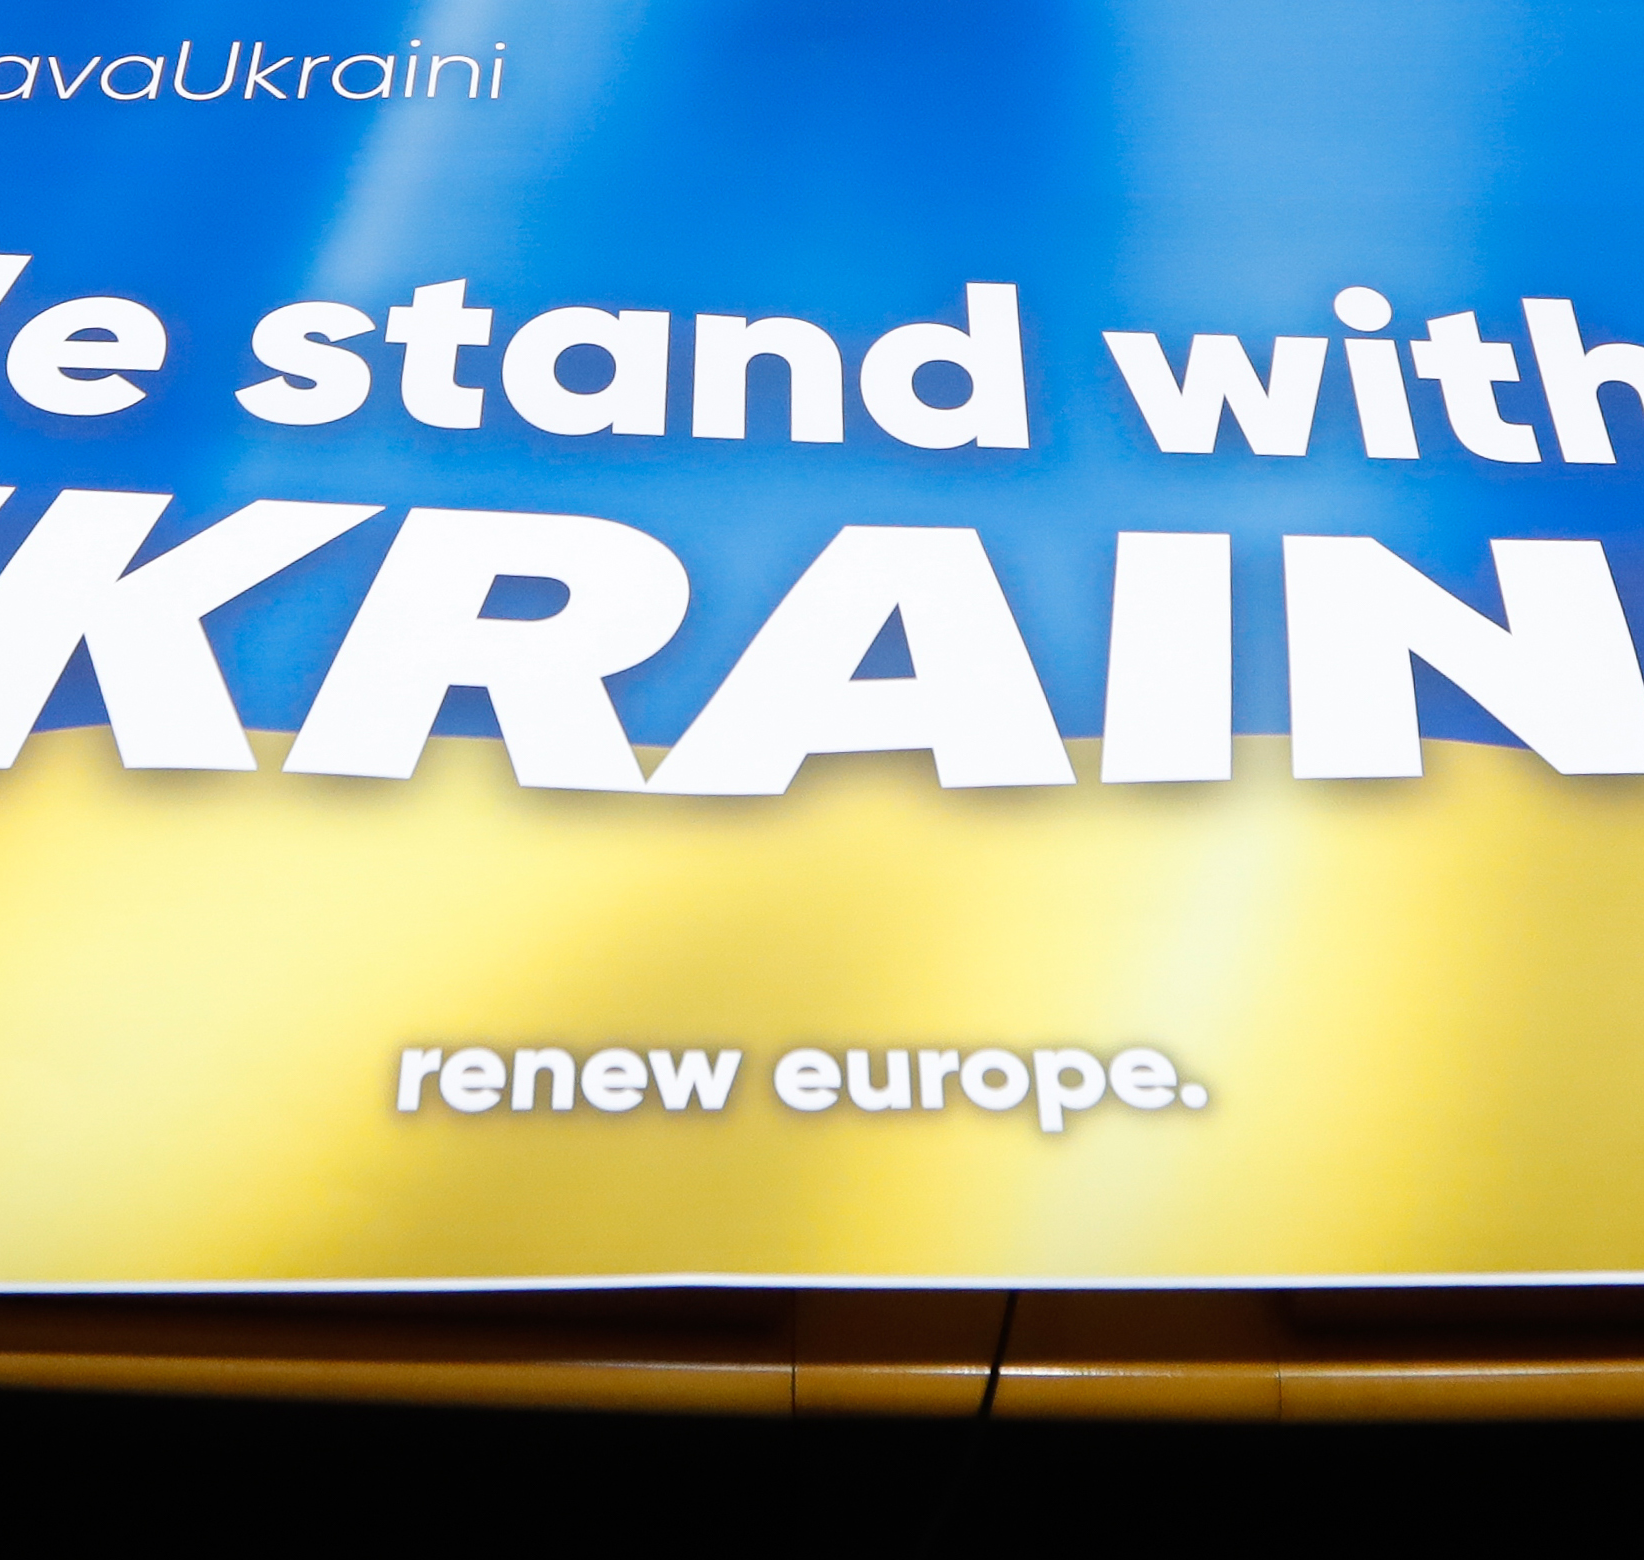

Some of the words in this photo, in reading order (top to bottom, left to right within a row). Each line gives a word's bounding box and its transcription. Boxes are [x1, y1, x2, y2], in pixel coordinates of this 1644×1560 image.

[234, 278, 1030, 449] stand
[396, 1047, 743, 1113] renew
[773, 1047, 1209, 1133] europe.
